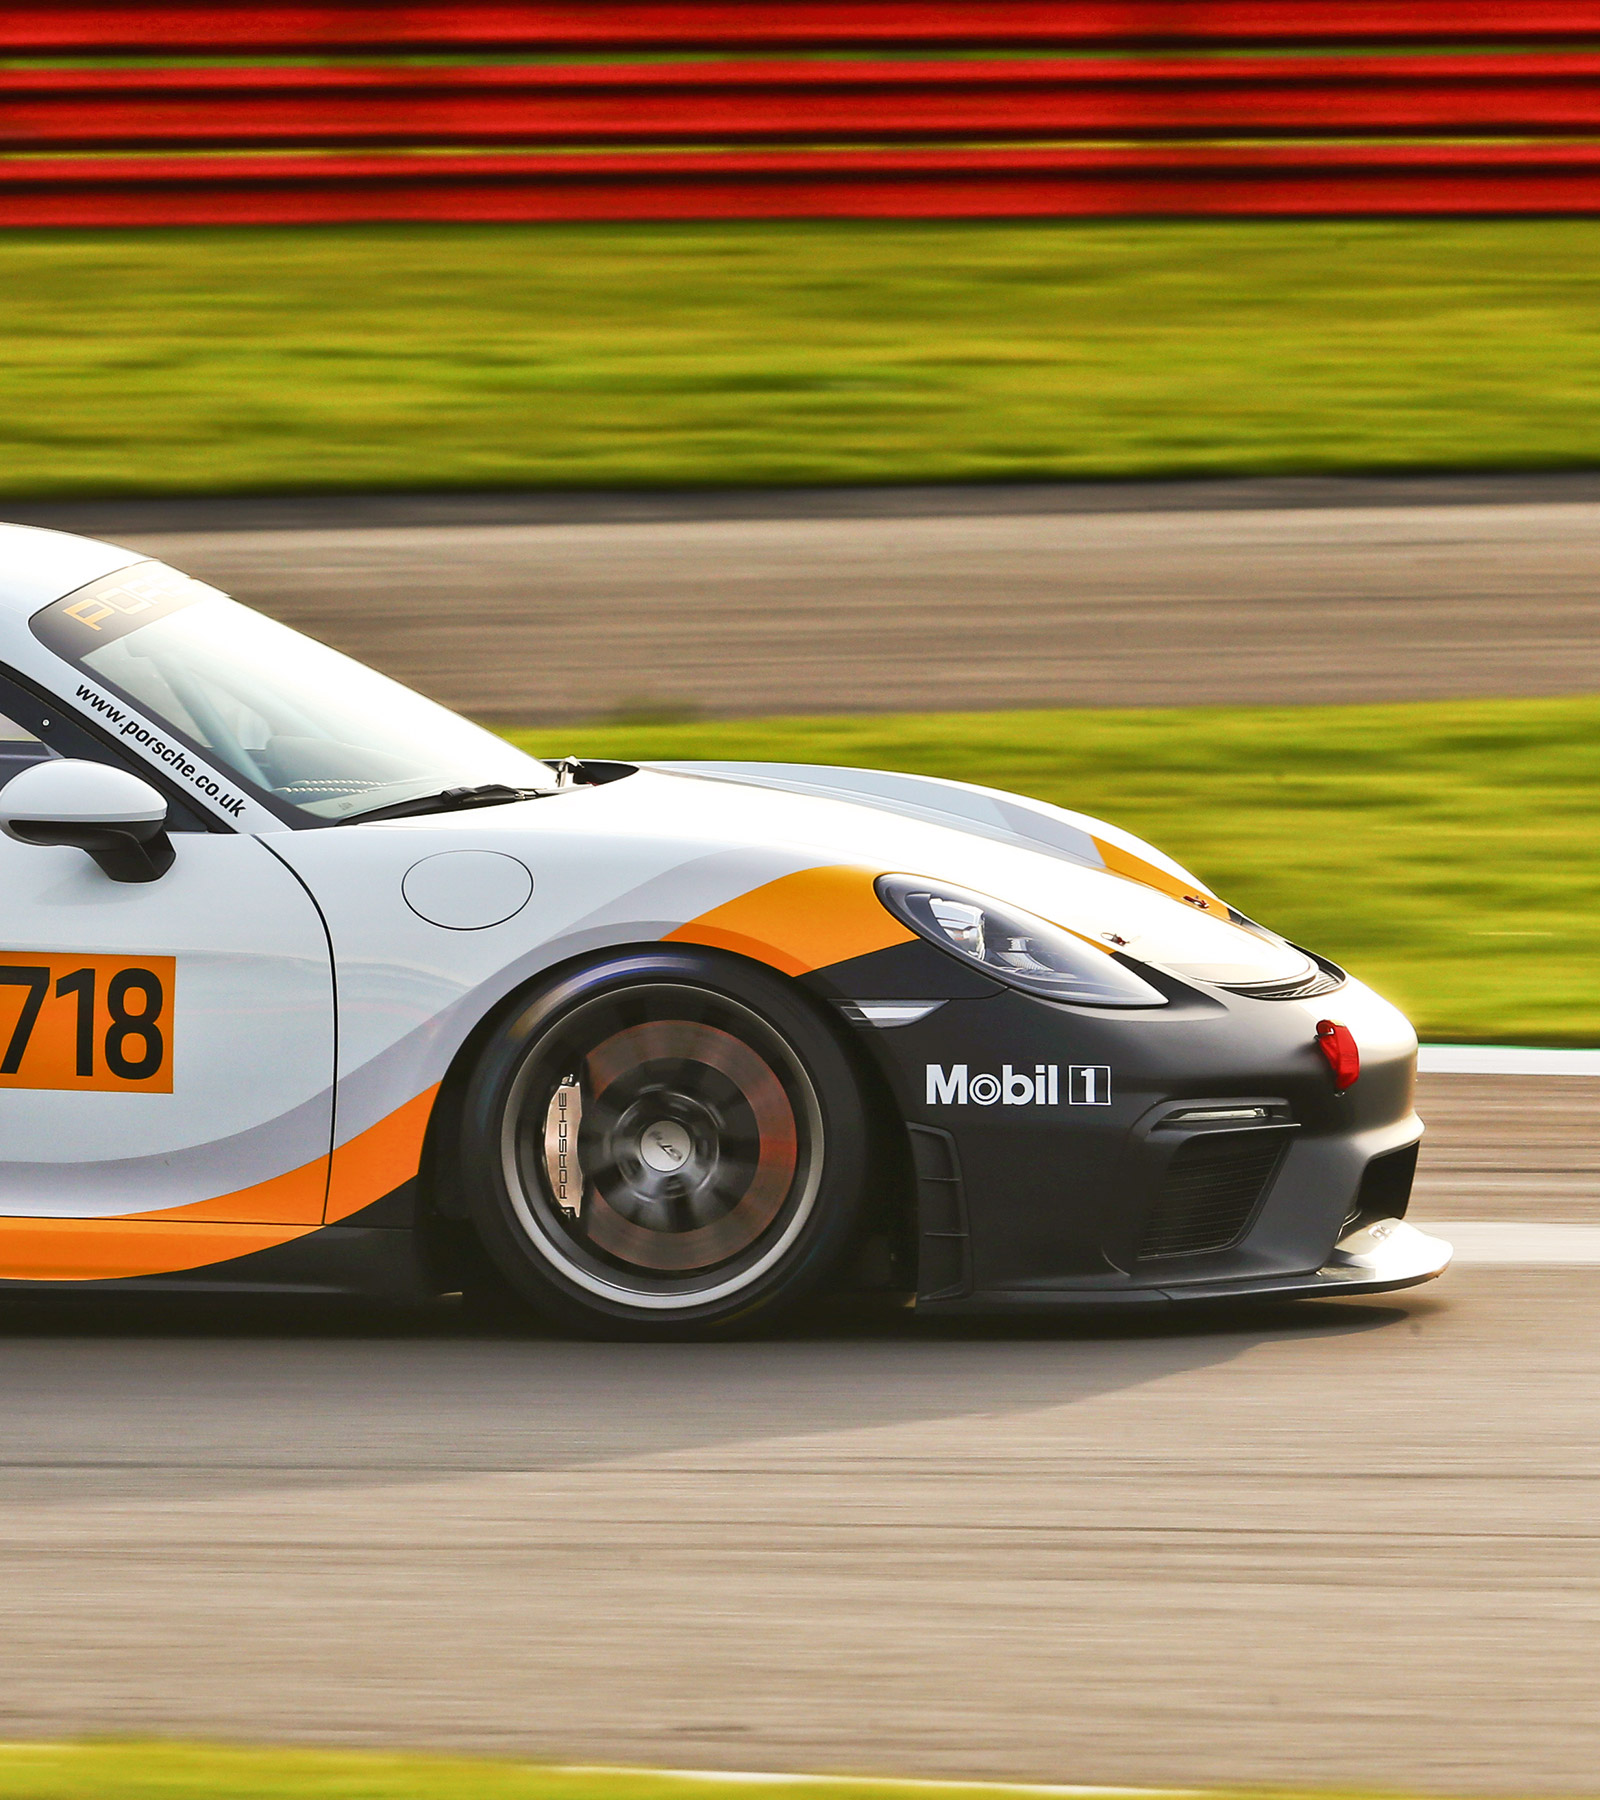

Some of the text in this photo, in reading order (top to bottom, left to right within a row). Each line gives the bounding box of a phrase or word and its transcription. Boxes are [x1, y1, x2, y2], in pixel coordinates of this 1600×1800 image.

[75, 684, 247, 818] www.porsche.co.uk
[926, 1064, 1058, 1106] Mobil
[559, 1093, 568, 1199] PORSCHE
